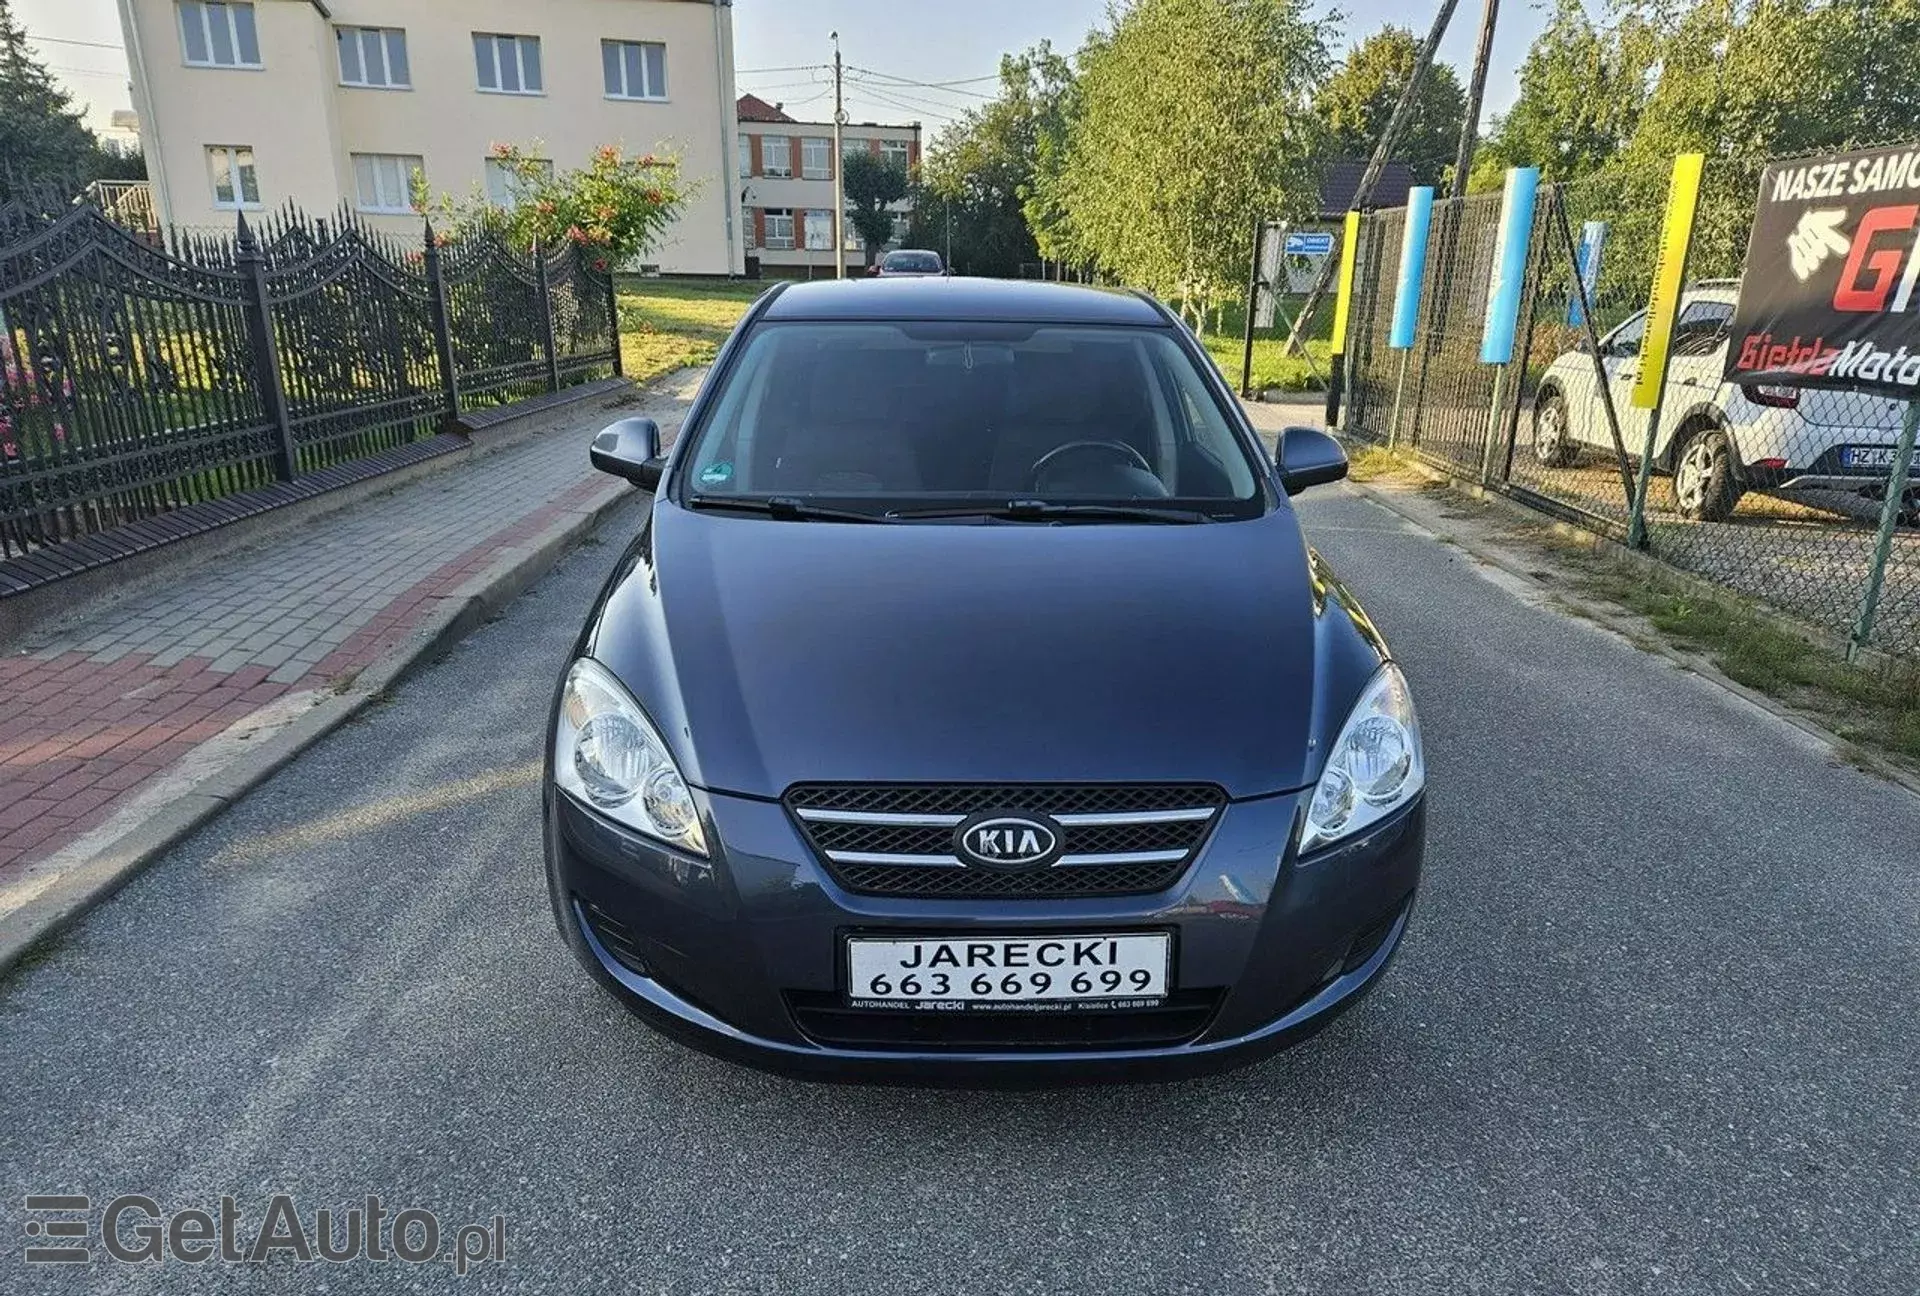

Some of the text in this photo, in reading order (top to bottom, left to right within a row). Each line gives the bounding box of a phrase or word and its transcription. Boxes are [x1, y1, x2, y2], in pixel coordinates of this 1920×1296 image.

[1772, 161, 1850, 202] NASZE
[979, 829, 1040, 854] KIA
[900, 941, 1118, 969] JARECKI
[870, 969, 1151, 995] 663 669 699
[851, 1000, 910, 1010] AUTOHANDEL
